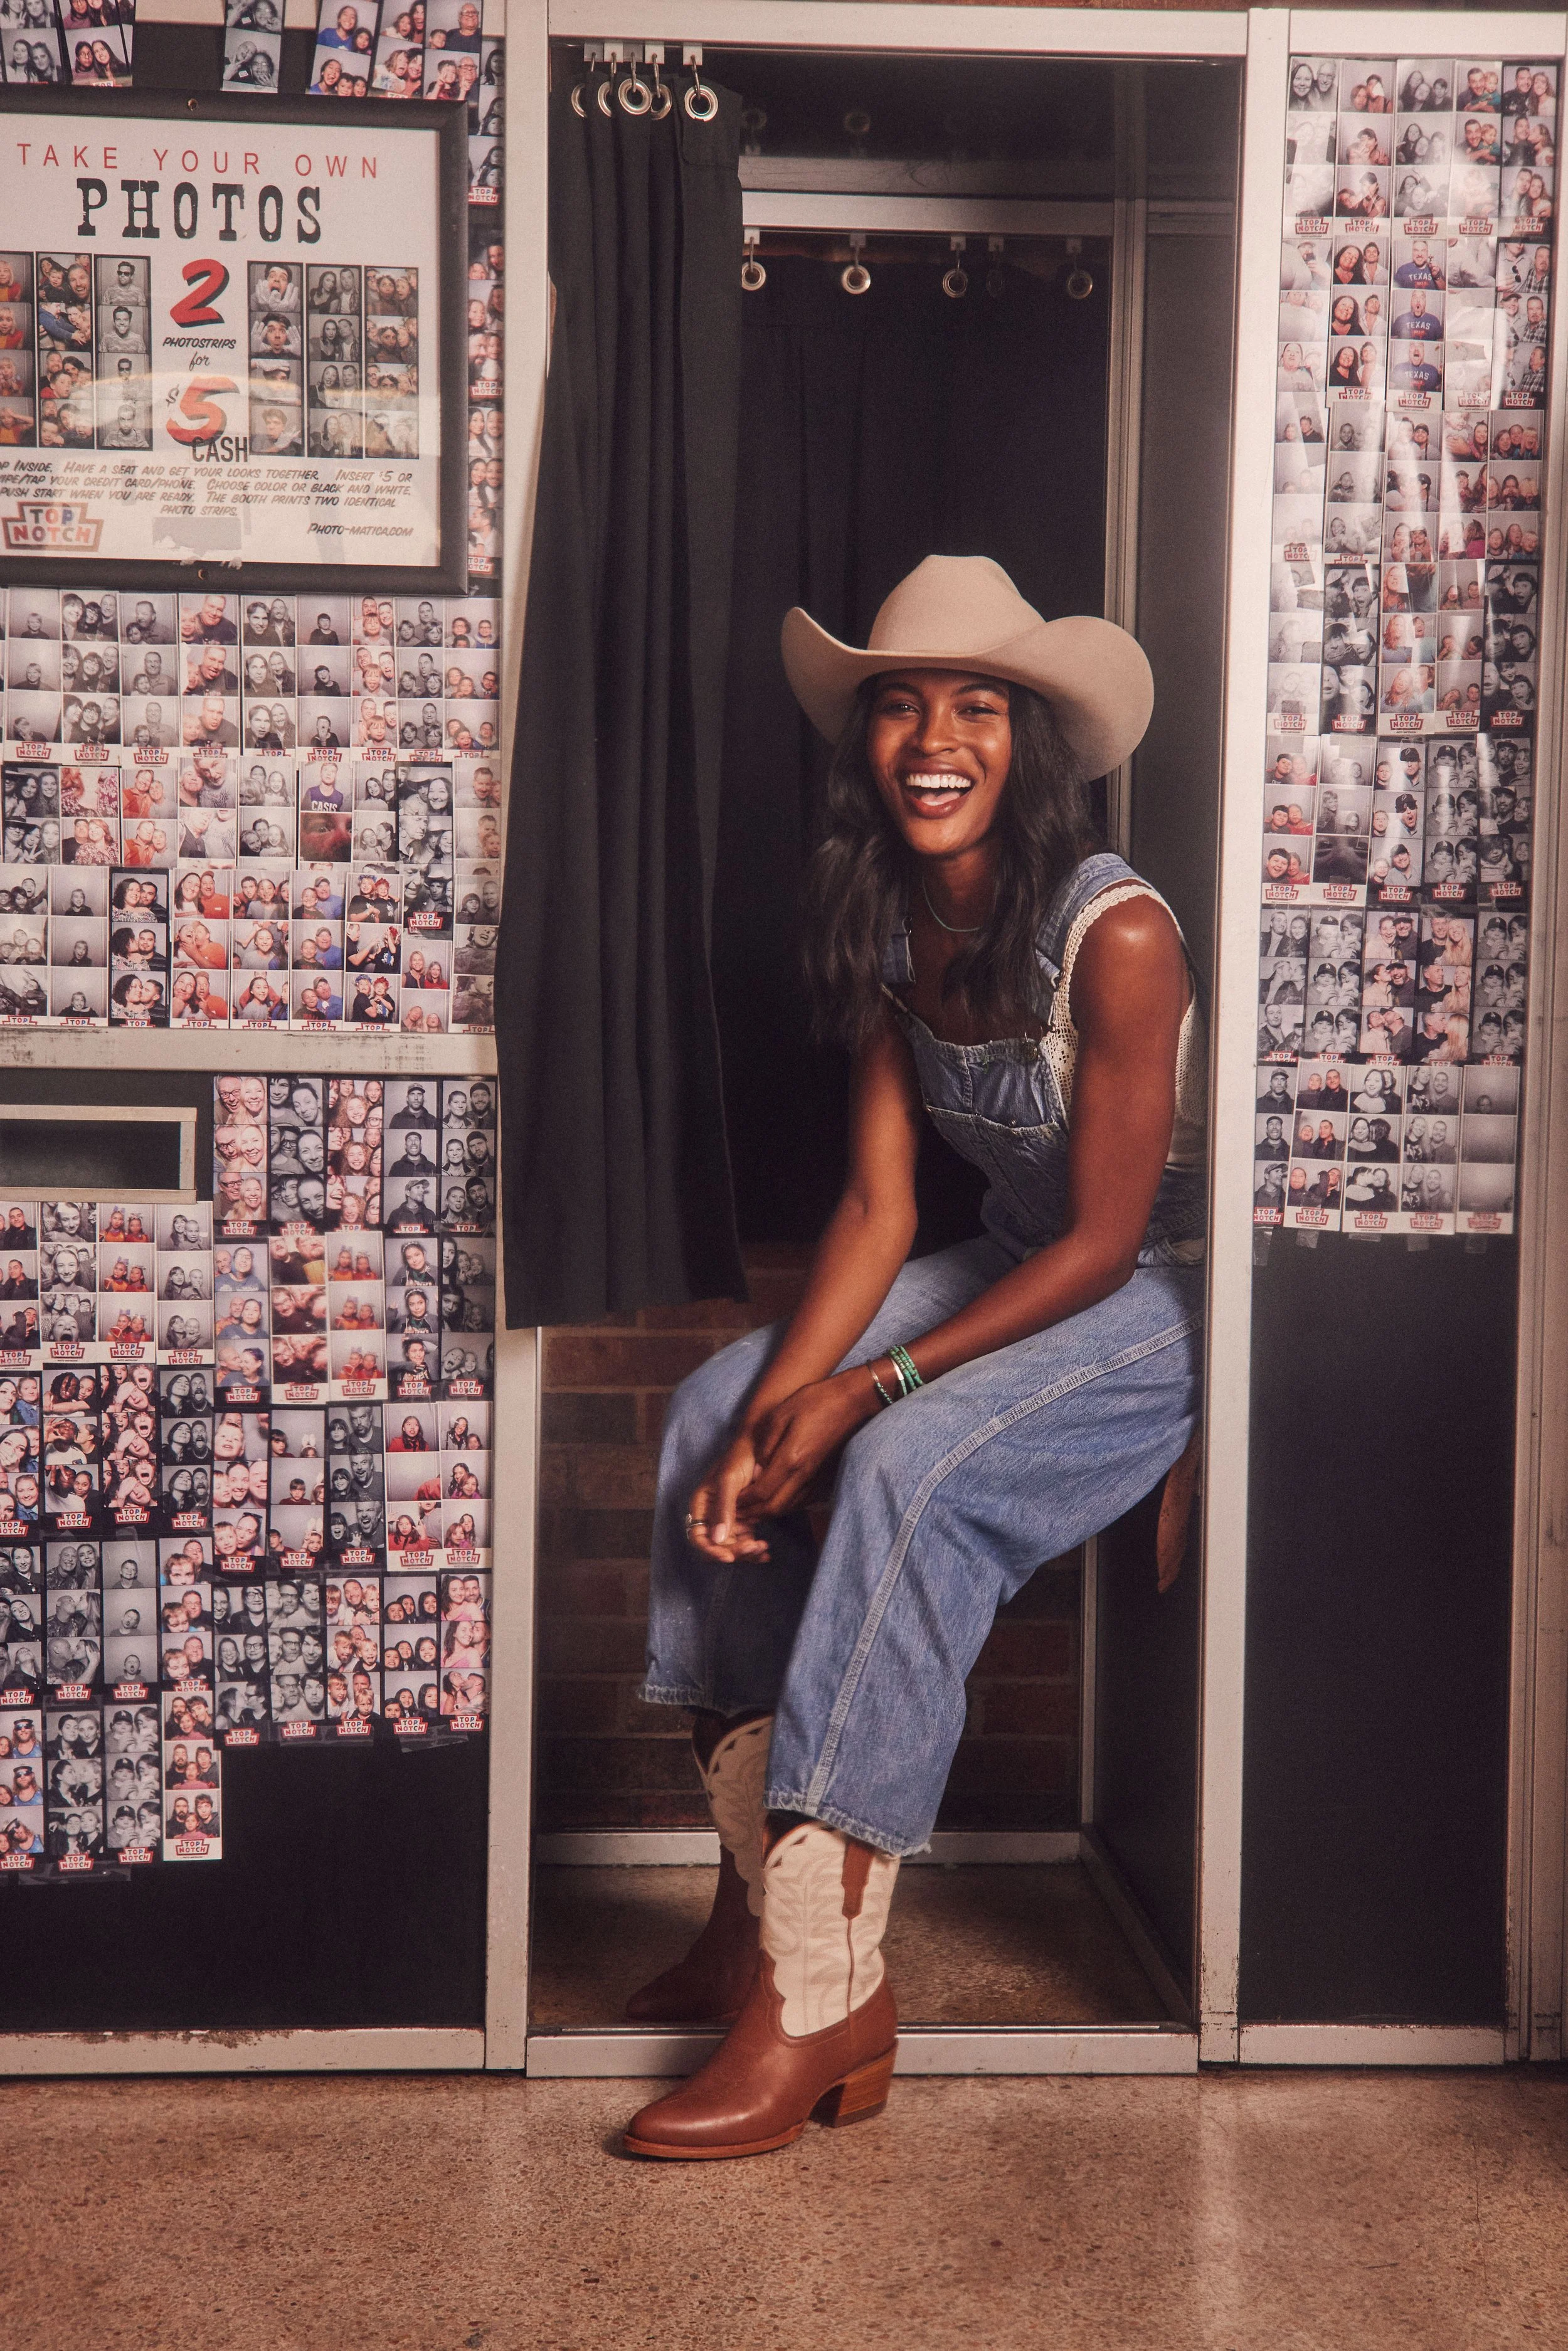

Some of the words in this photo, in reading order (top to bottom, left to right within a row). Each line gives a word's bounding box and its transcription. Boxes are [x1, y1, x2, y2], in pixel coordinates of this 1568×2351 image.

[17, 144, 118, 169] TAKE
[153, 149, 260, 174] YOUR
[295, 154, 376, 178] OWN
[77, 178, 321, 243] PHOTOS
[1409, 272, 1432, 281] TEXAS
[170, 258, 230, 328] 2
[163, 337, 236, 349] PHOTOSTRIPS
[189, 351, 209, 371] for
[191, 437, 248, 462] CASH
[14, 460, 52, 472] INSIDE.
[64, 462, 95, 473] HAVE
[100, 465, 107, 474] A
[112, 465, 138, 475] SEAT
[141, 466, 164, 475] AND
[169, 467, 190, 475] GET
[194, 467, 223, 477] YOUR
[227, 469, 261, 478] LOOKS
[336, 469, 375, 481] INSERT
[398, 473, 412, 482] OR
[0, 474, 46, 484] IPE/TAP
[50, 476, 78, 486] YOUR
[83, 477, 122, 487] CREDIT
[207, 479, 250, 491] CHOOSE
[254, 483, 286, 492] COLOR
[292, 483, 306, 492] OR
[310, 484, 344, 492] BLACK
[347, 485, 369, 493] AND
[0, 487, 29, 497] PUSH
[33, 489, 66, 498] START
[70, 490, 103, 499] WHEN
[109, 491, 131, 500] YOU
[135, 492, 156, 501] ARE
[207, 491, 226, 502] THE
[231, 494, 267, 504] BOOTH
[271, 496, 310, 505] PRINTS
[315, 496, 339, 506] TWO
[344, 497, 396, 507] IDENTICAL
[30, 509, 74, 524] TOP
[161, 505, 196, 514] PHOTO
[13, 526, 92, 542] NOTCH
